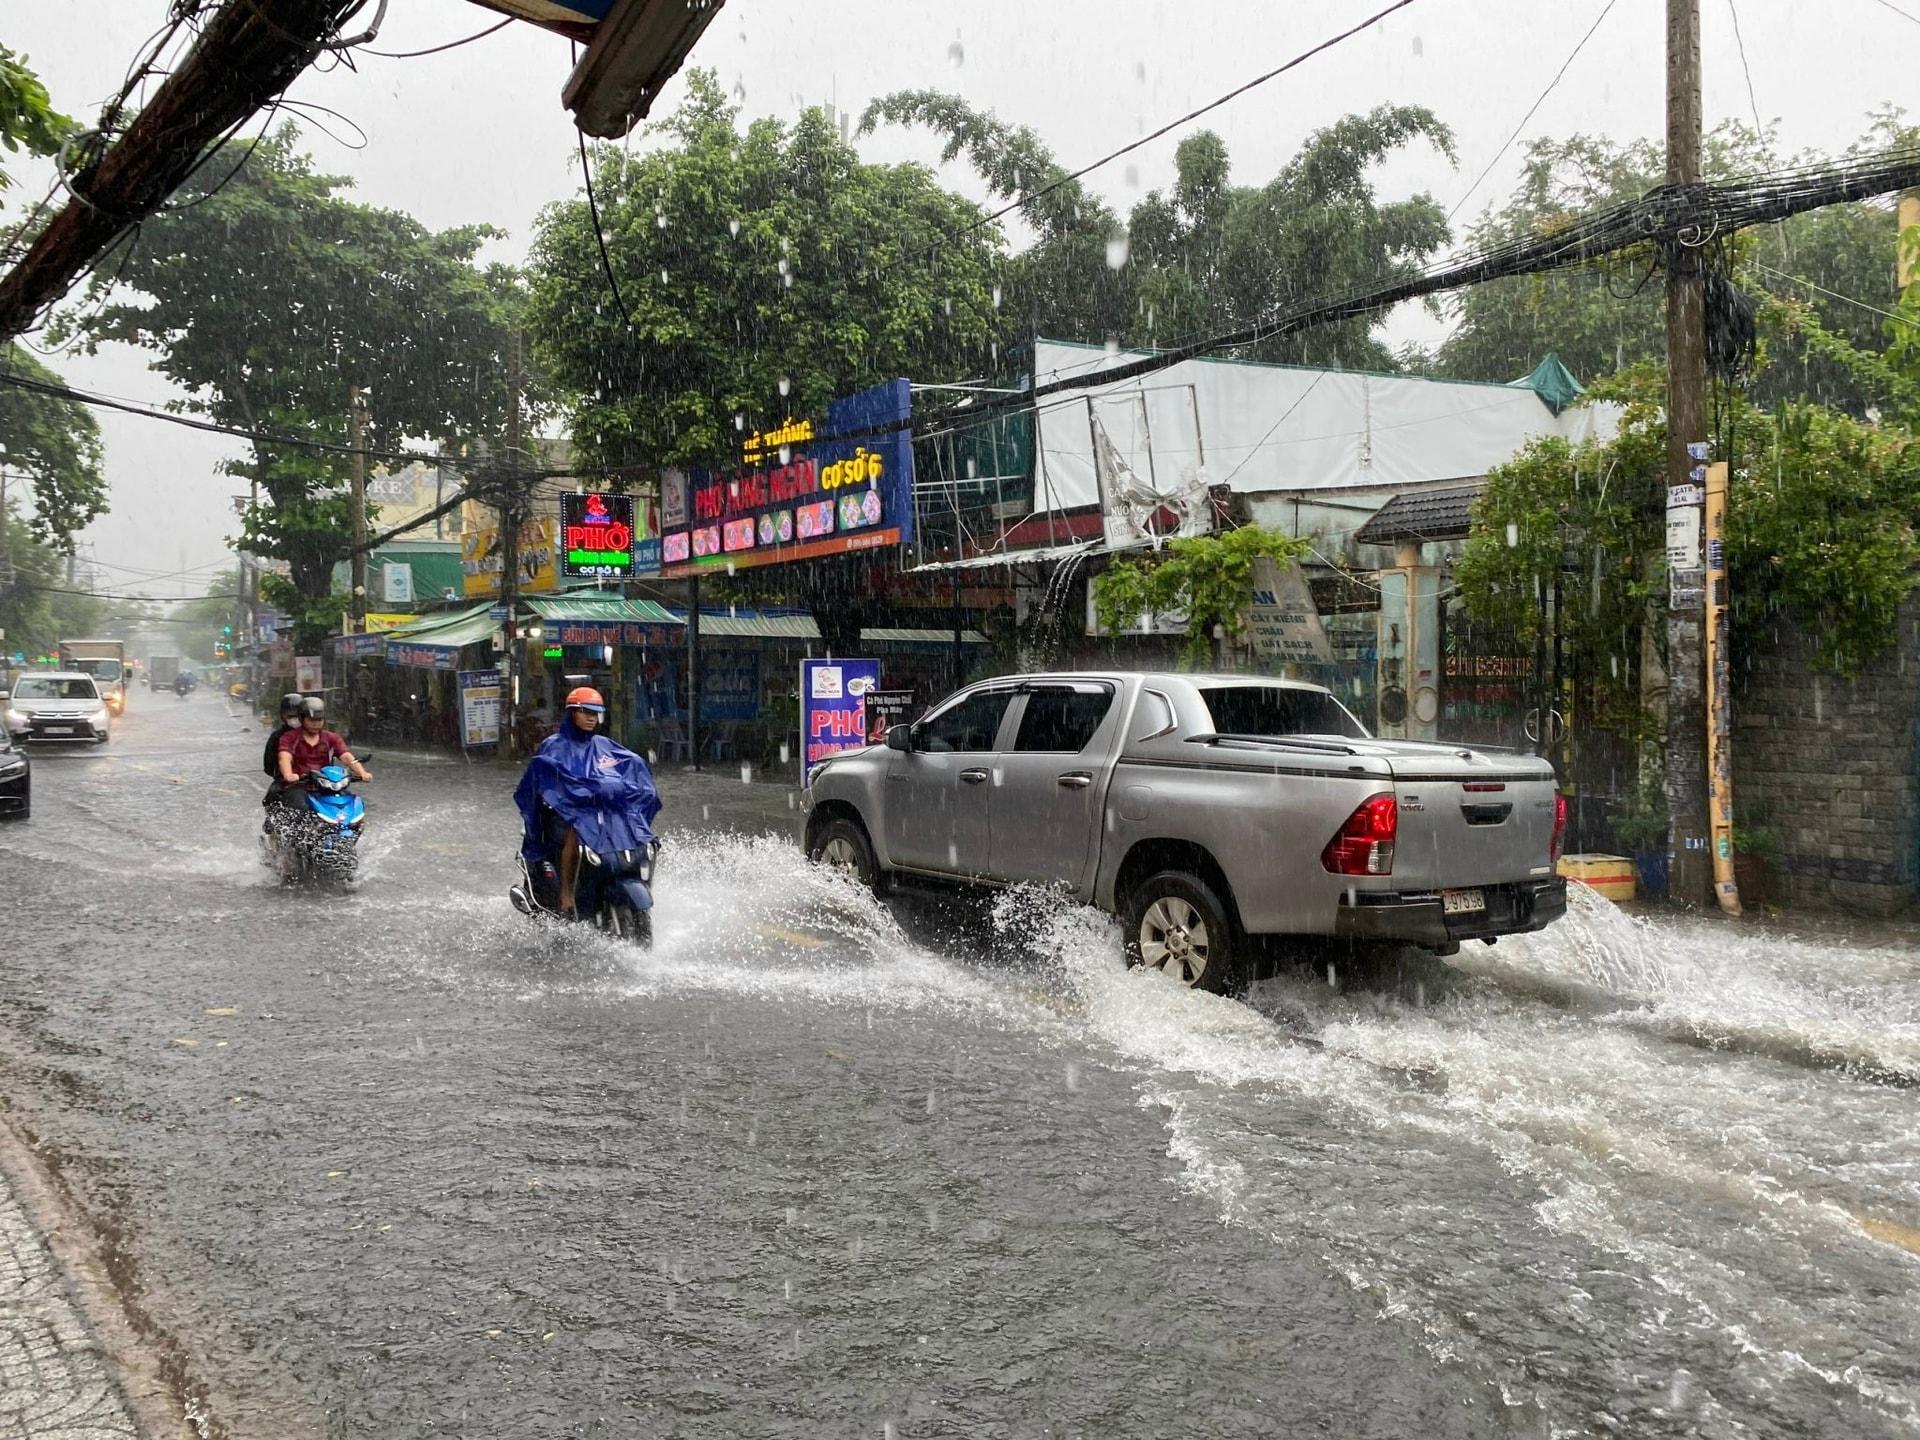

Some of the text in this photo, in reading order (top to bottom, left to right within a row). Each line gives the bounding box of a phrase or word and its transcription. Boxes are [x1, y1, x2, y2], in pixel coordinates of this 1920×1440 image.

[843, 447, 866, 484] SỞ
[868, 454, 883, 478] 6
[567, 521, 630, 551] PHỞ
